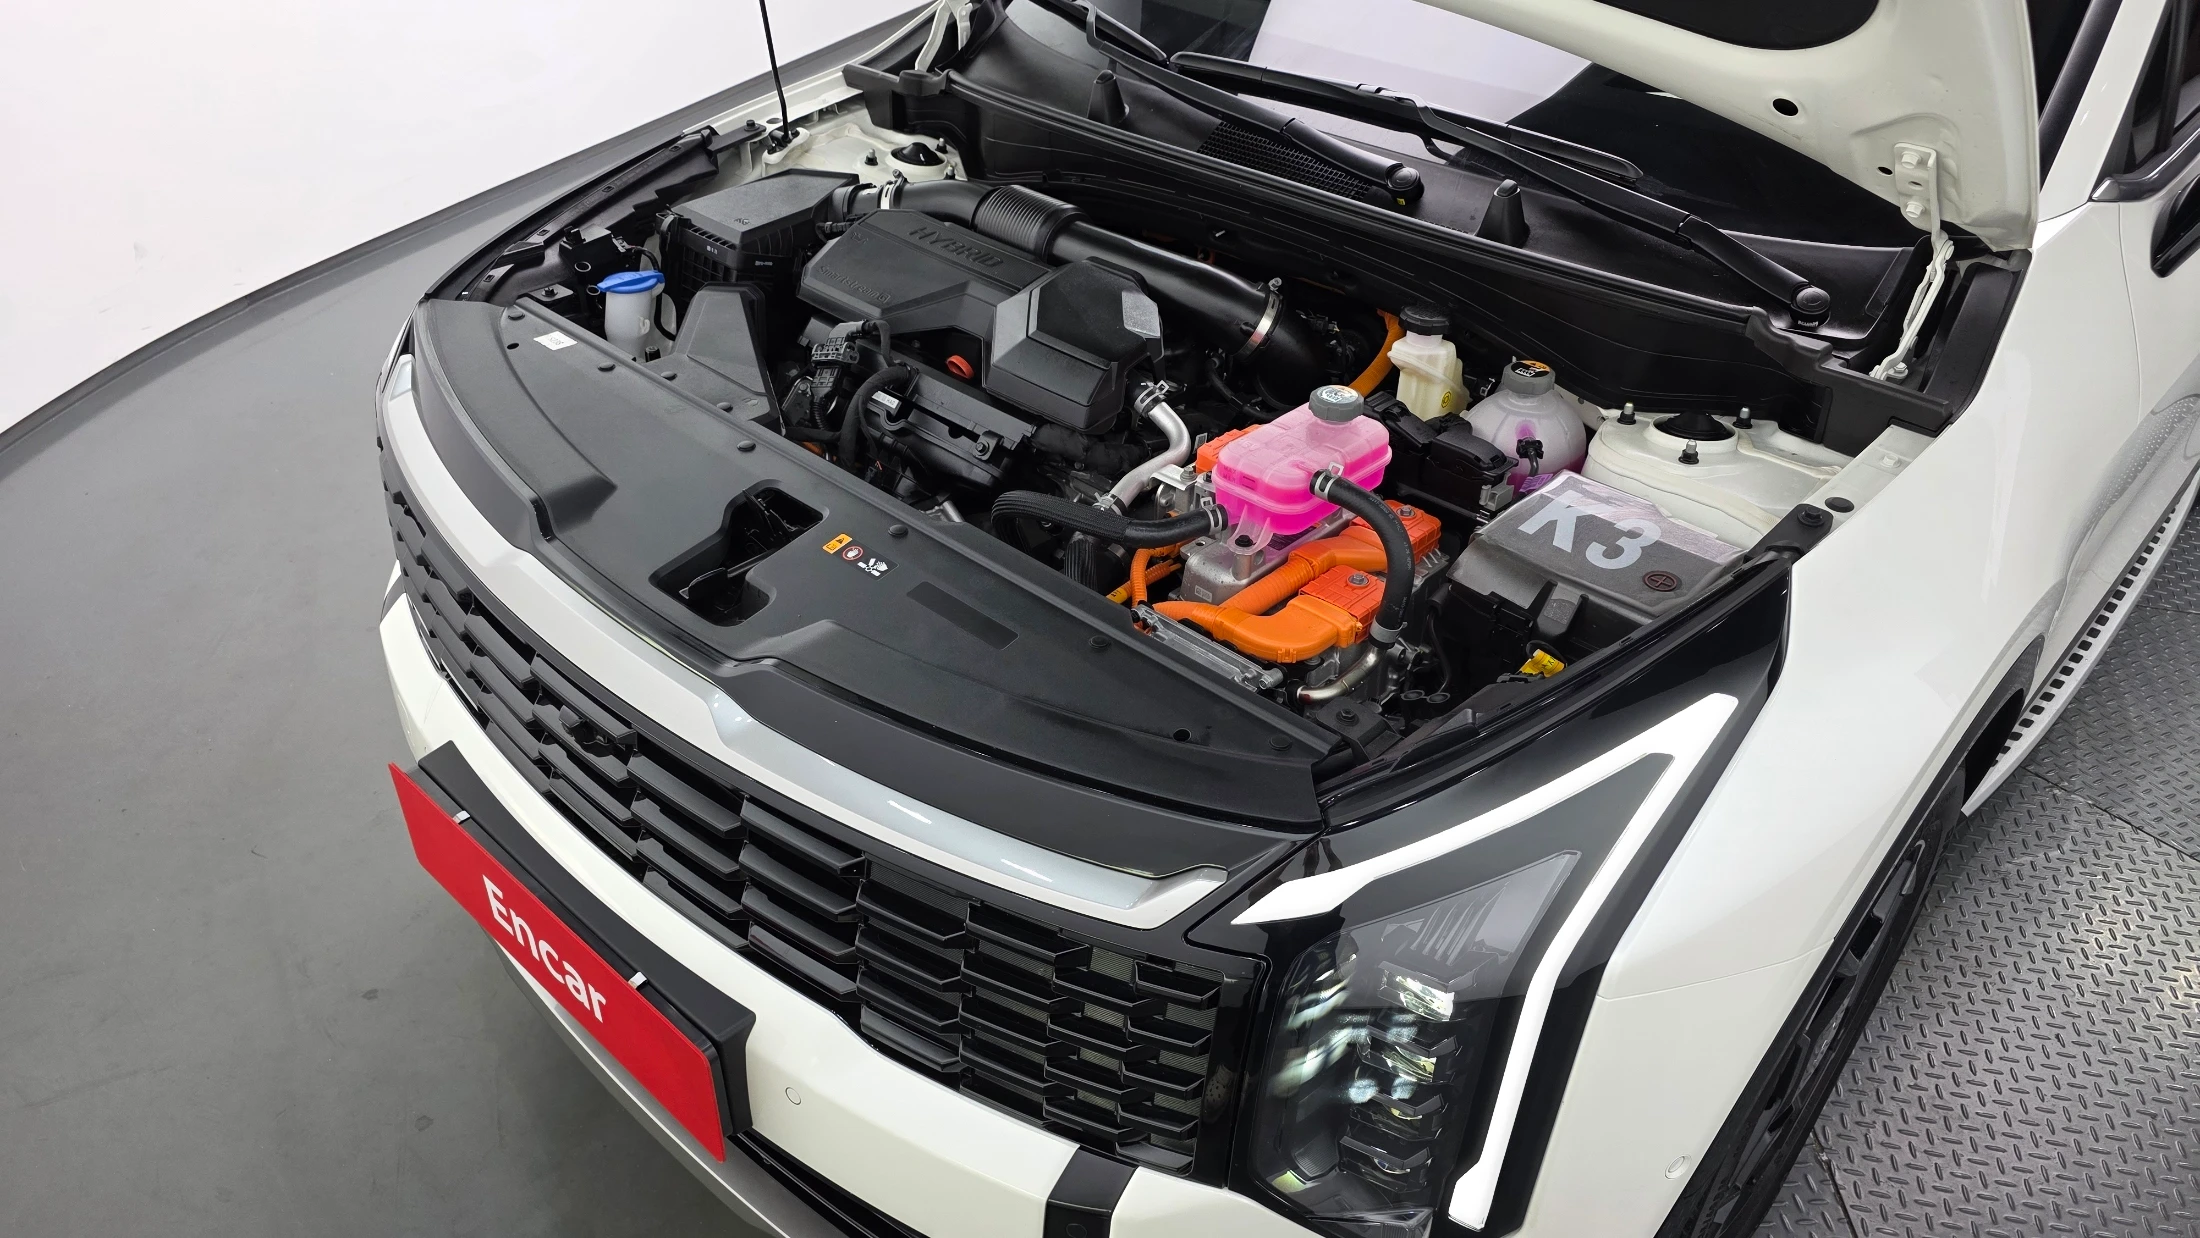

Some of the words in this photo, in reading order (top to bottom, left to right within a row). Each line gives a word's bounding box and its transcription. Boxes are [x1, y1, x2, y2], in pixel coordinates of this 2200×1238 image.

[907, 226, 1004, 267] HYBRID
[1517, 489, 1662, 570] K3
[482, 874, 607, 1023] Encar
